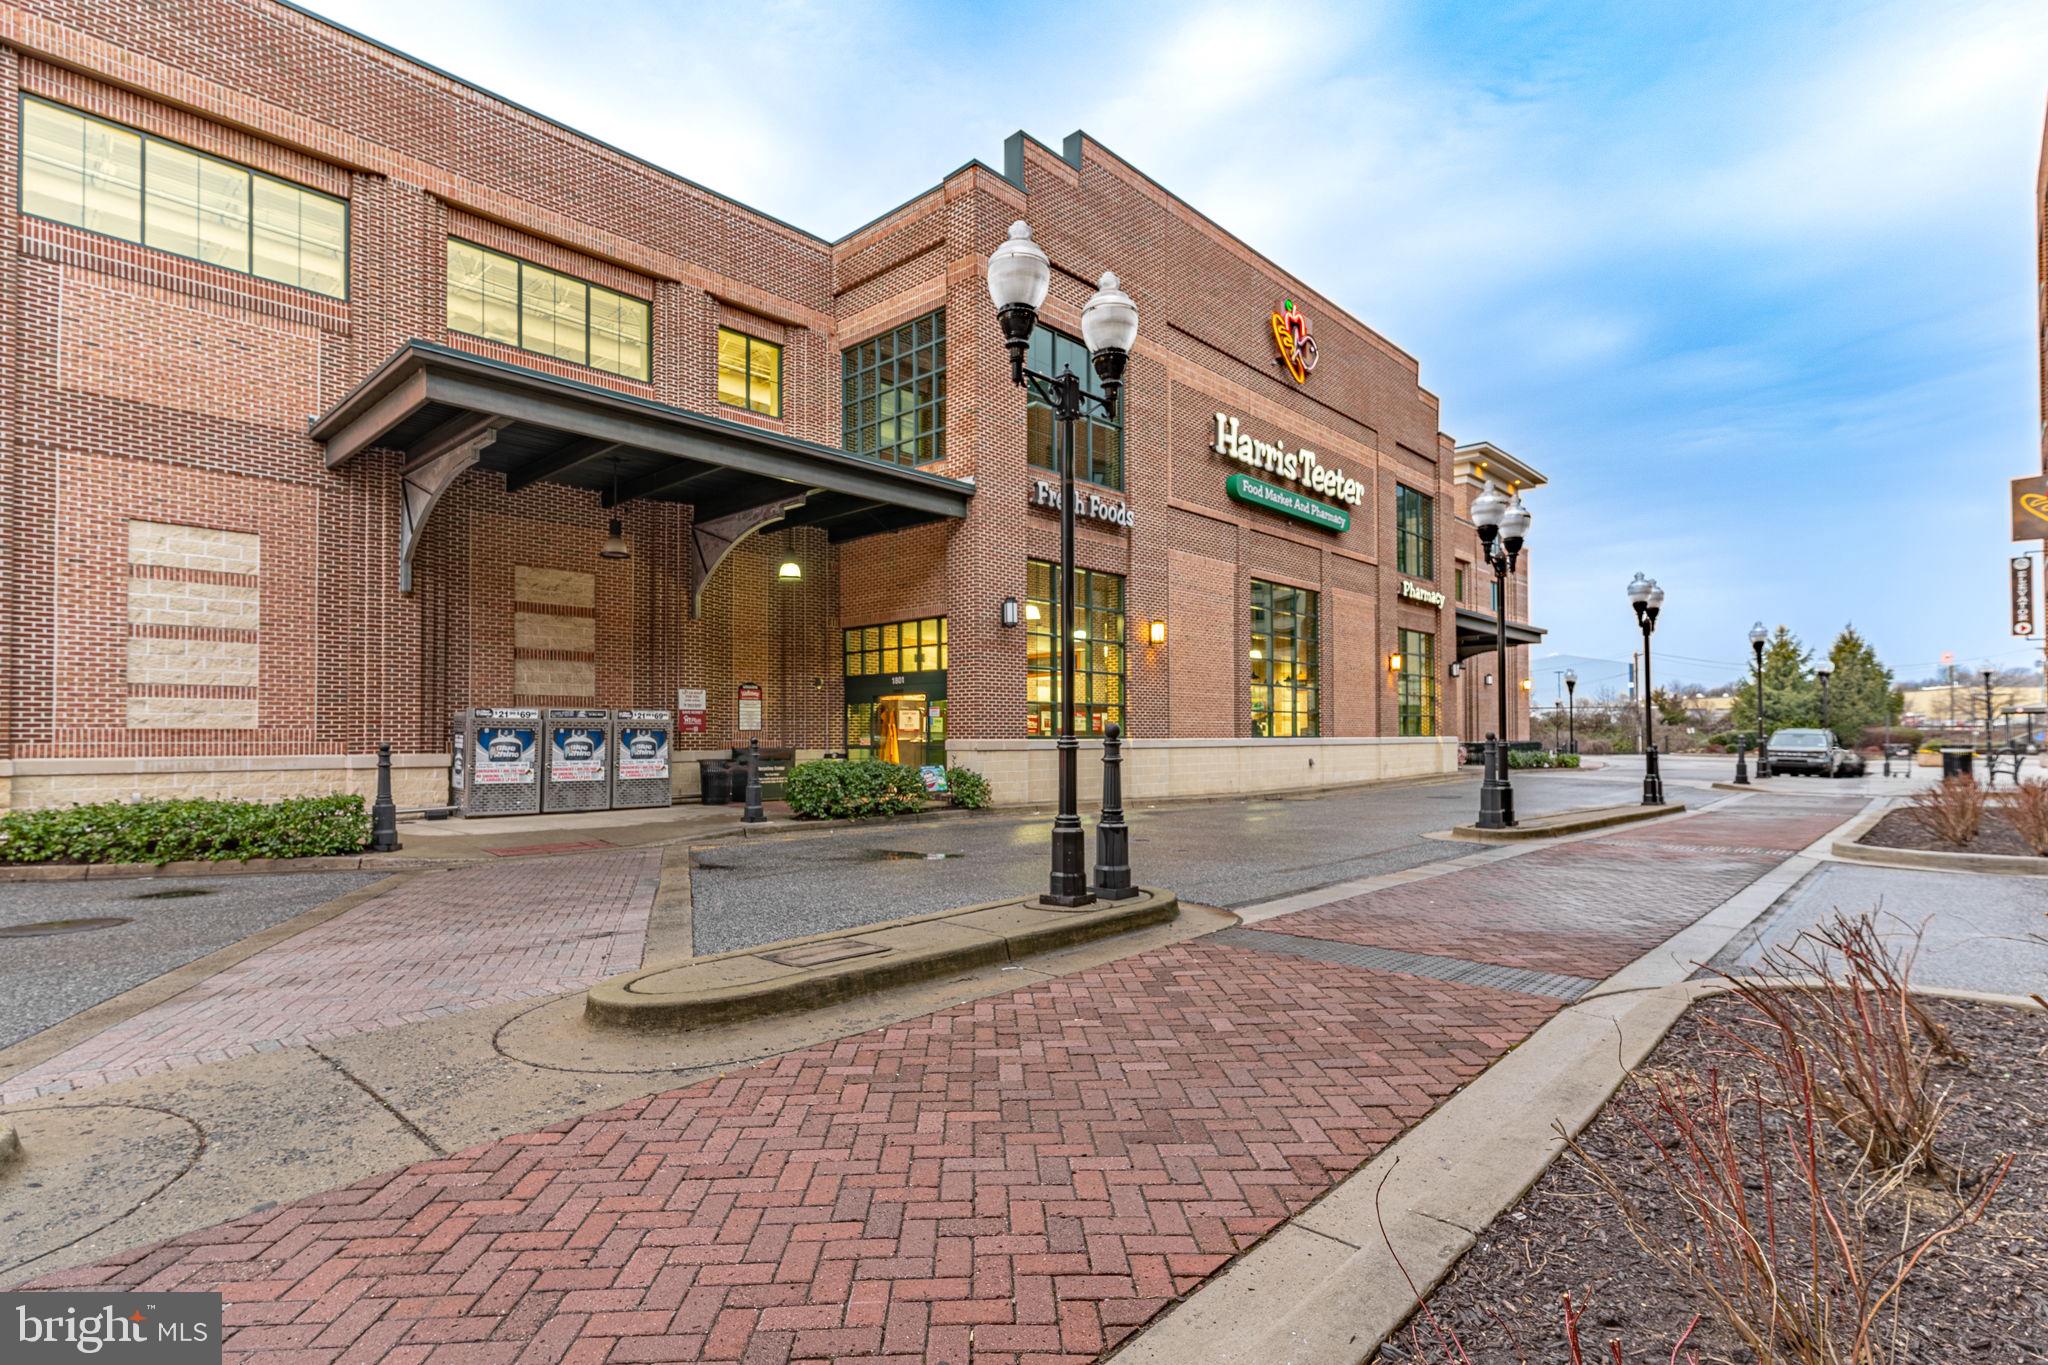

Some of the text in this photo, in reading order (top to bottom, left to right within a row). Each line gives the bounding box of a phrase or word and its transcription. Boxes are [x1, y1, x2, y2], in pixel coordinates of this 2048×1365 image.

[1215, 412, 1365, 505] Harris Teeter
[1037, 480, 1135, 527] Freh Foods
[1242, 479, 1346, 528] Food Market And Pharmacy
[1402, 580, 1445, 609] Pharmacy
